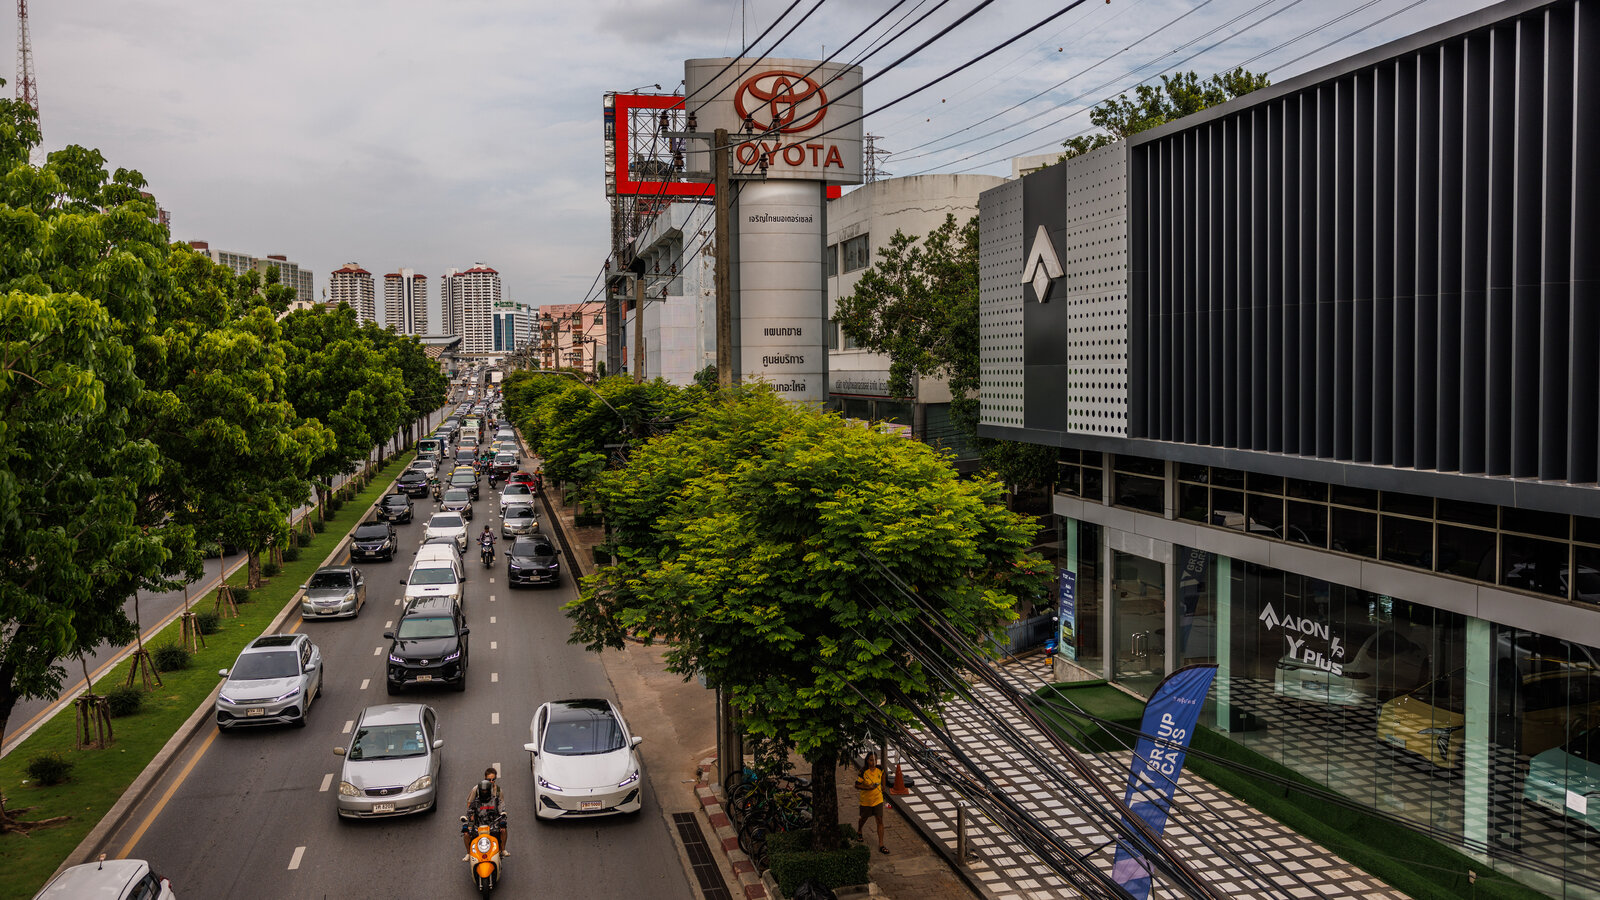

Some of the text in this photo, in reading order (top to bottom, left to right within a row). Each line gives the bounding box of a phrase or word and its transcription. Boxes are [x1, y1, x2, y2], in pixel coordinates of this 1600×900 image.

[736, 142, 845, 168] OYOTA
[764, 327, 802, 336] แผนกขาย
[762, 352, 805, 368] ศูนย์บริการ
[768, 379, 806, 392] นกอะไหล่
[1281, 614, 1329, 640] AION
[1286, 635, 1343, 676] Y Plus
[1146, 713, 1175, 771] GROUP
[1161, 728, 1186, 775] CARS
